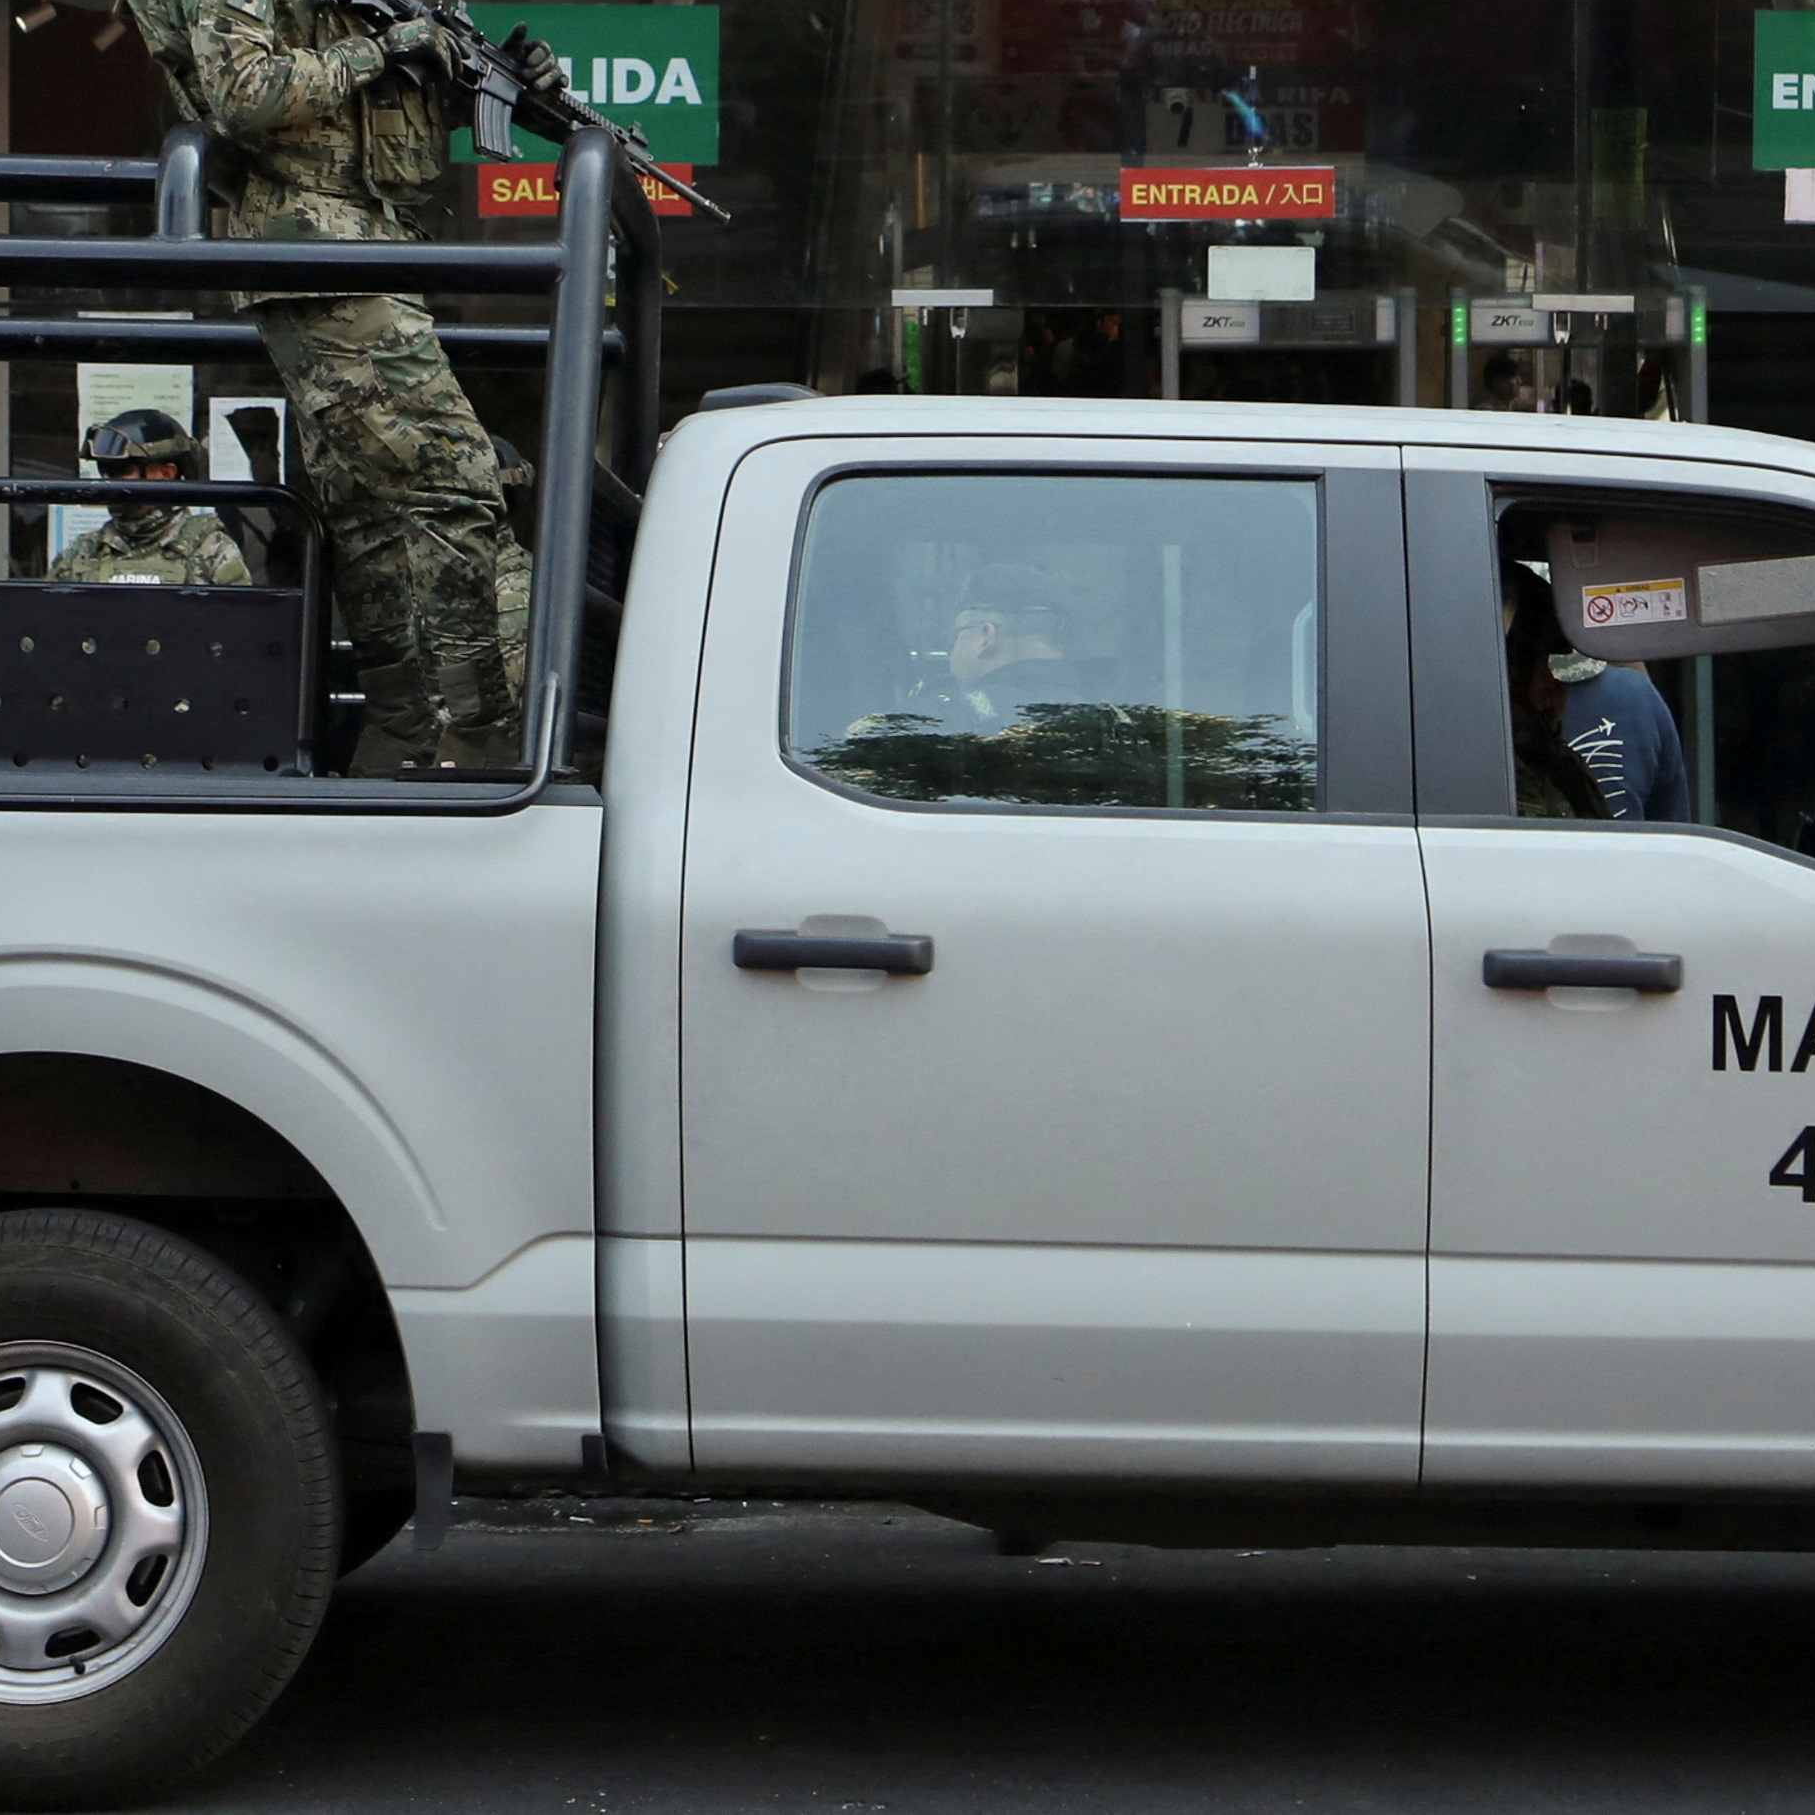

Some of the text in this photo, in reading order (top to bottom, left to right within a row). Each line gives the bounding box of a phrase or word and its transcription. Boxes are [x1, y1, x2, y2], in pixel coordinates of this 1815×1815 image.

[557, 57, 703, 105] LIDA
[1224, 111, 1314, 146] DAS
[1131, 182, 1324, 206] ENTRADA / 入口
[108, 573, 162, 584] MARINA
